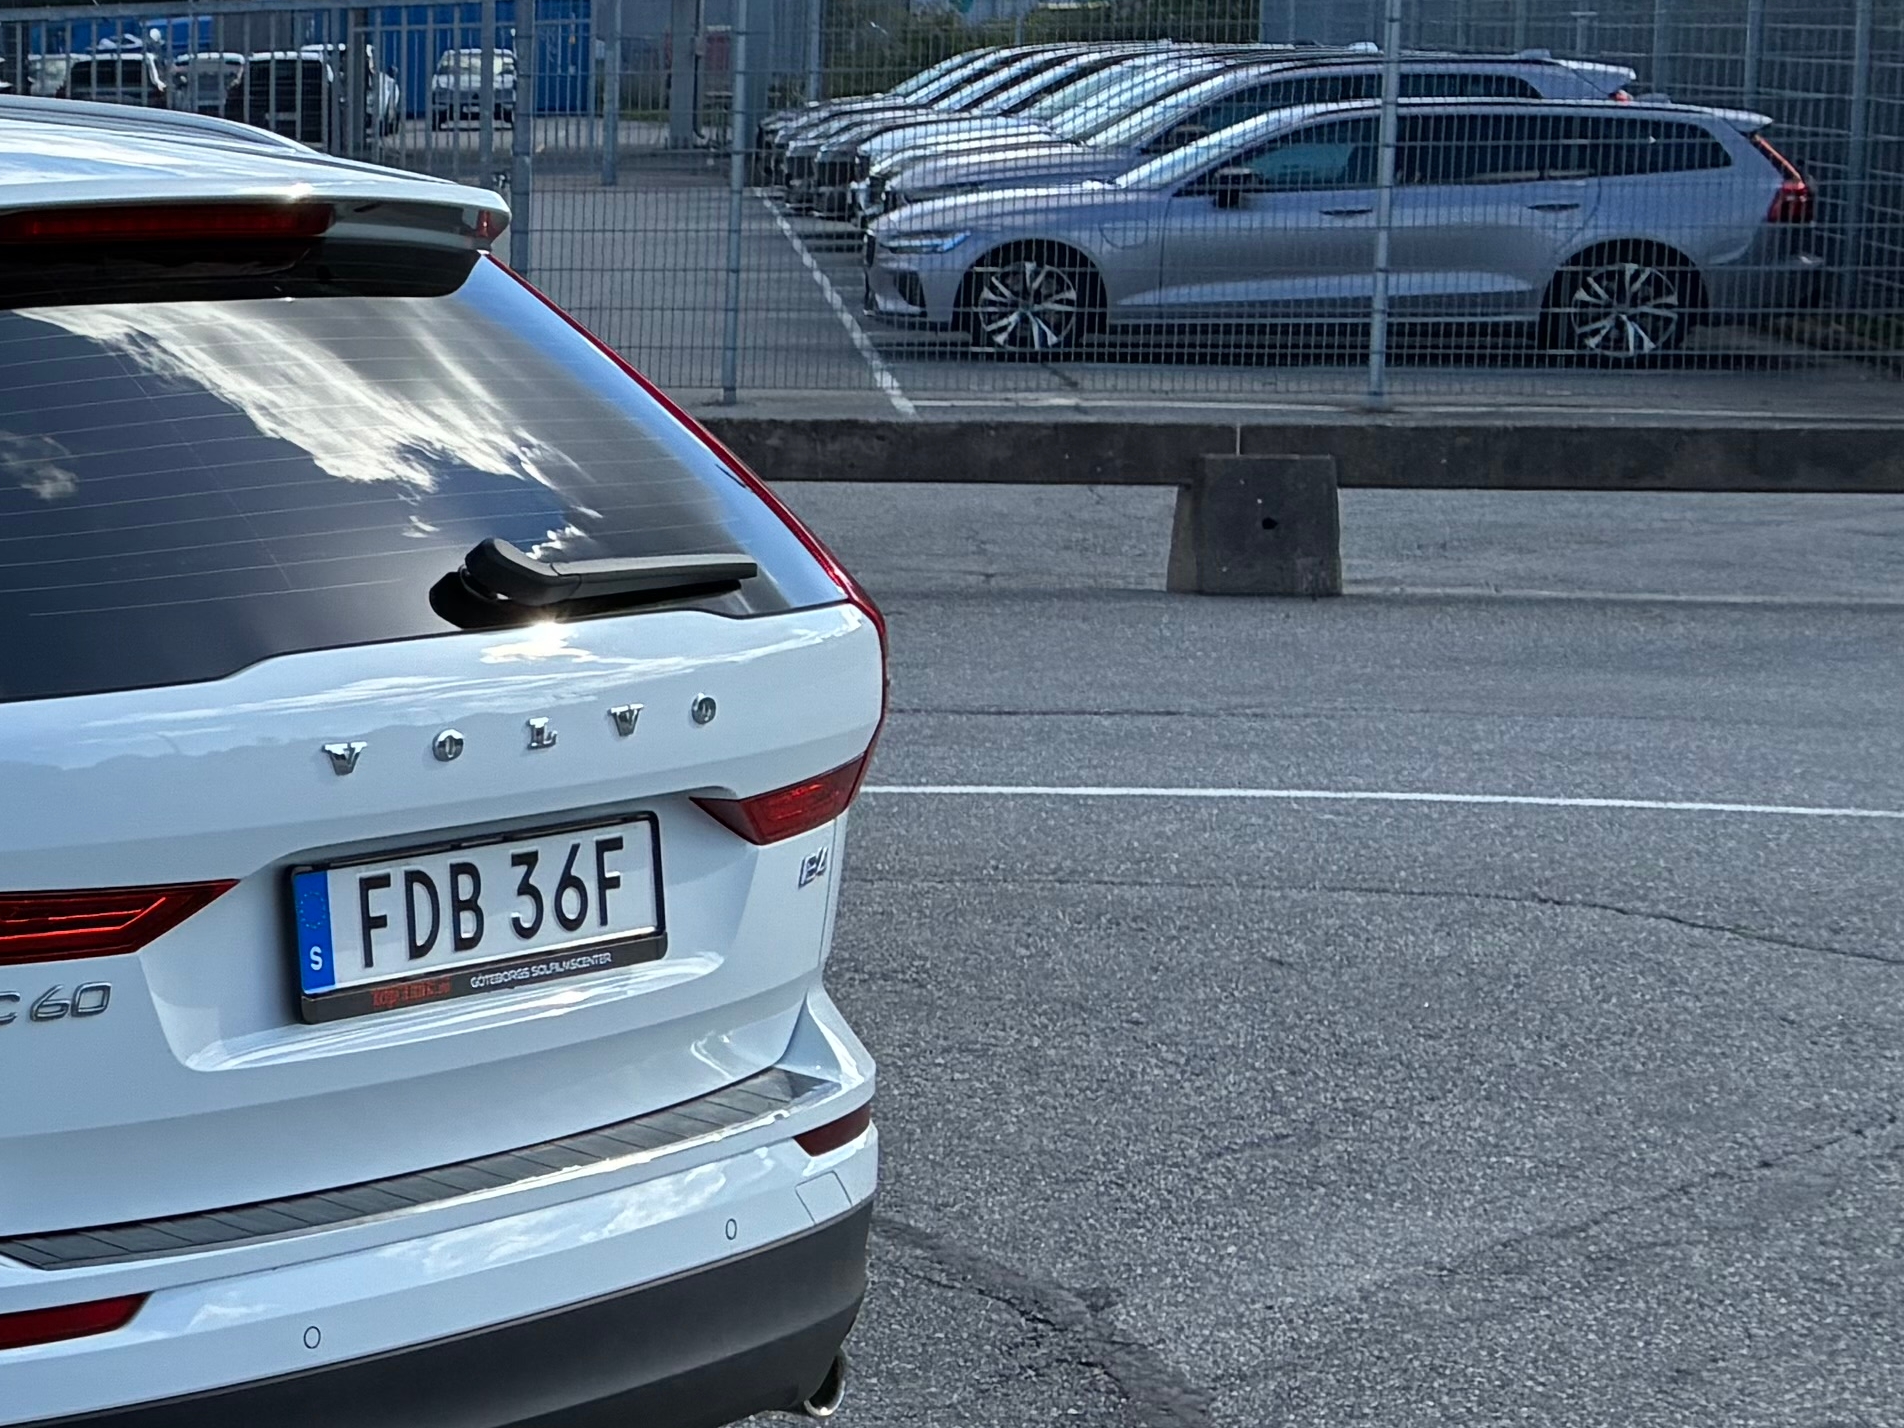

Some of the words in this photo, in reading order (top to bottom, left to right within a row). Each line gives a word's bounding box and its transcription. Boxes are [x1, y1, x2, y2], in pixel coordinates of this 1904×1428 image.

[321, 692, 717, 776] VOLVO
[358, 862, 484, 968] FDB
[510, 836, 624, 940] 36F
[310, 946, 323, 971] S
